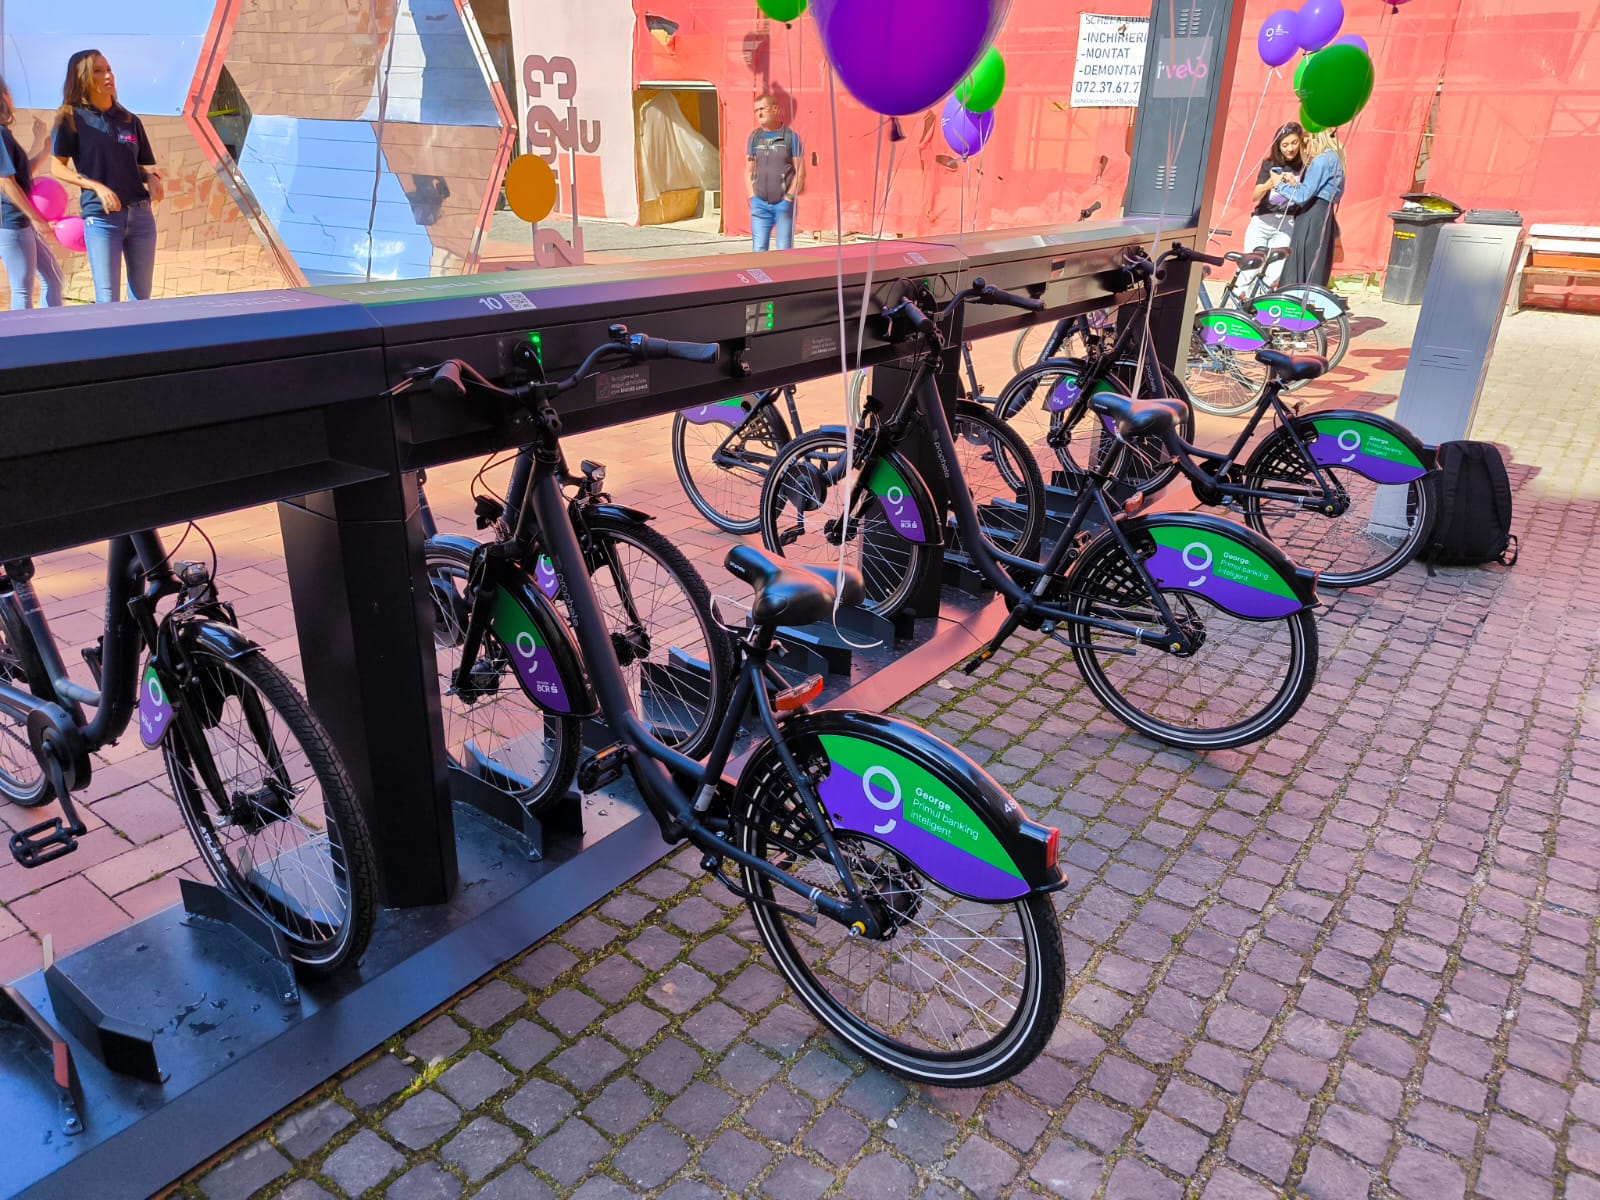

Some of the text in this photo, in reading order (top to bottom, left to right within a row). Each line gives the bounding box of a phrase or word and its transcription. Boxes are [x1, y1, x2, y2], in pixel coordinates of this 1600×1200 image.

[1081, 48, 1130, 59] -MONTAT
[1079, 65, 1144, 76] -DEMONTAT
[479, 297, 503, 310] 10
[557, 573, 579, 627] prophete
[915, 787, 953, 813] George.
[912, 798, 979, 841] Primul banking
